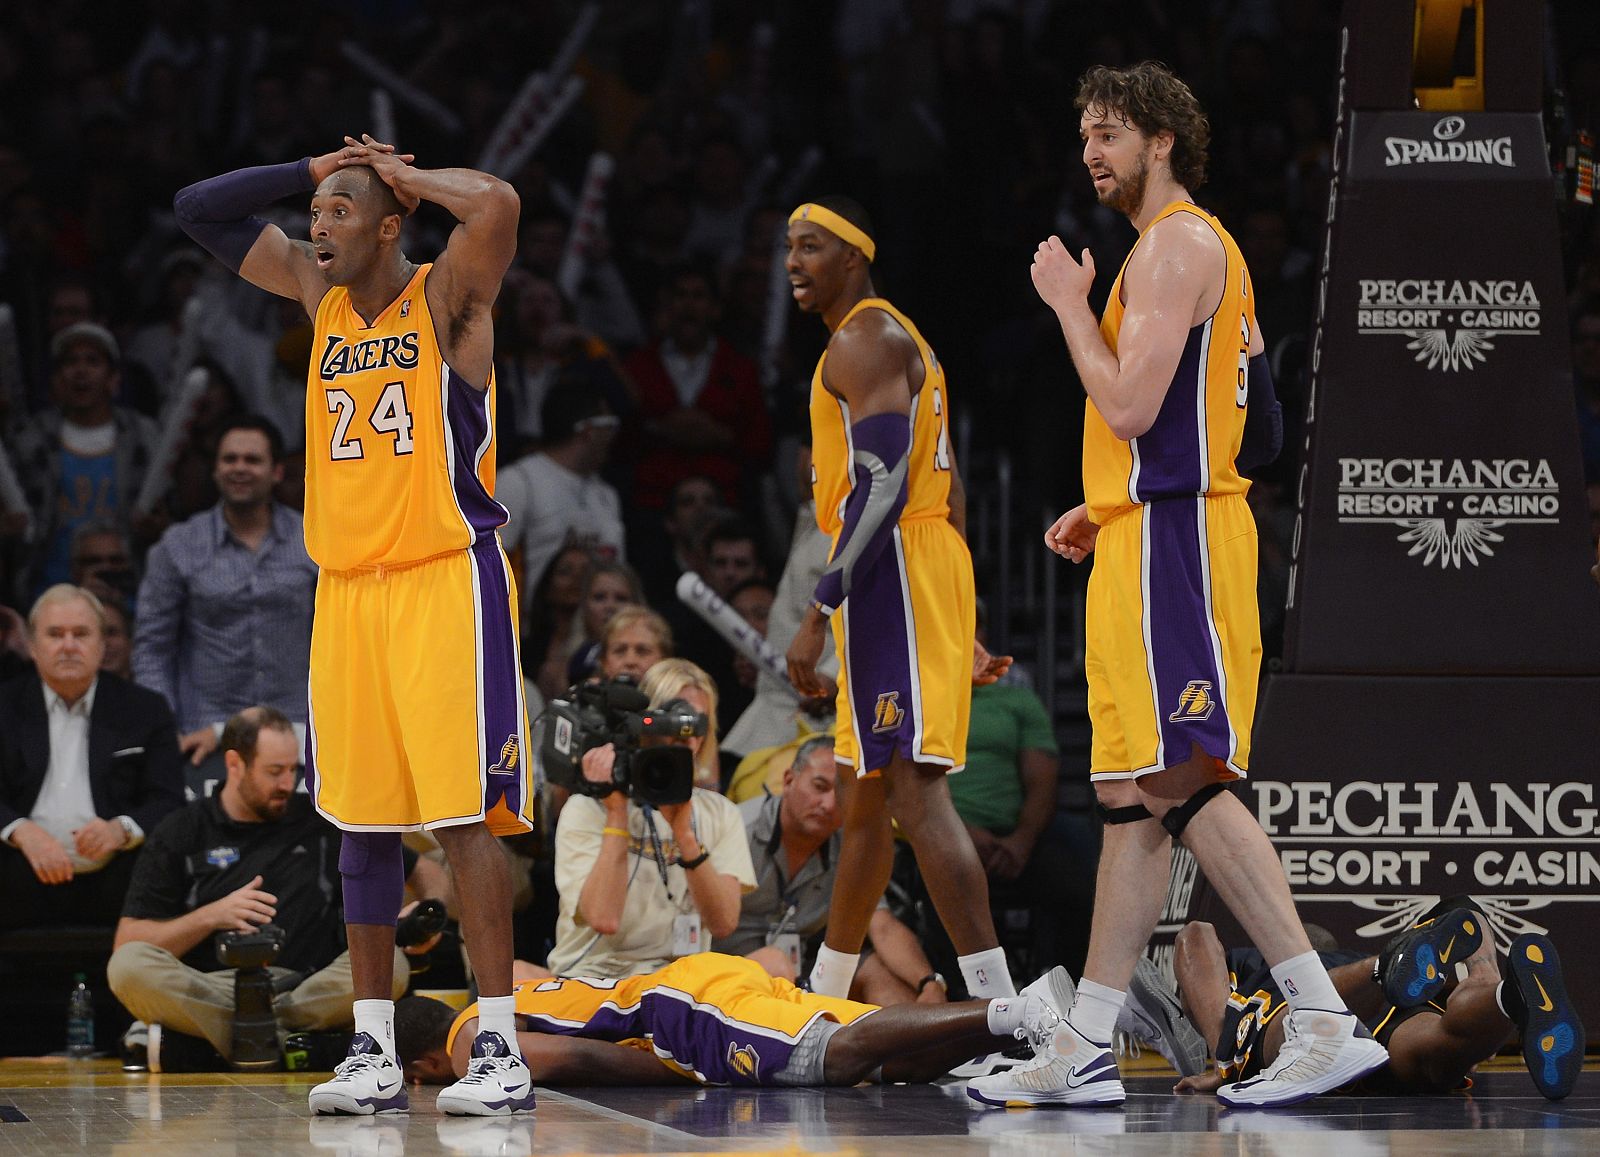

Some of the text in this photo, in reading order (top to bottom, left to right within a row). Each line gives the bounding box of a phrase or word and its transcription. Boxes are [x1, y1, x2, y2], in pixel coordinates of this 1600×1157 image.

[1385, 136, 1513, 167] SPALDING
[1359, 280, 1540, 304] PECHANGA
[1358, 310, 1540, 328] RESORT CASINO
[320, 332, 419, 381] LAKERS
[325, 381, 413, 461] 24
[1338, 458, 1559, 489] PECHANGA
[1338, 495, 1560, 516] RESORT CASINO
[1252, 781, 1600, 836] PECHANG
[1280, 849, 1600, 886] ESORT CASIN
